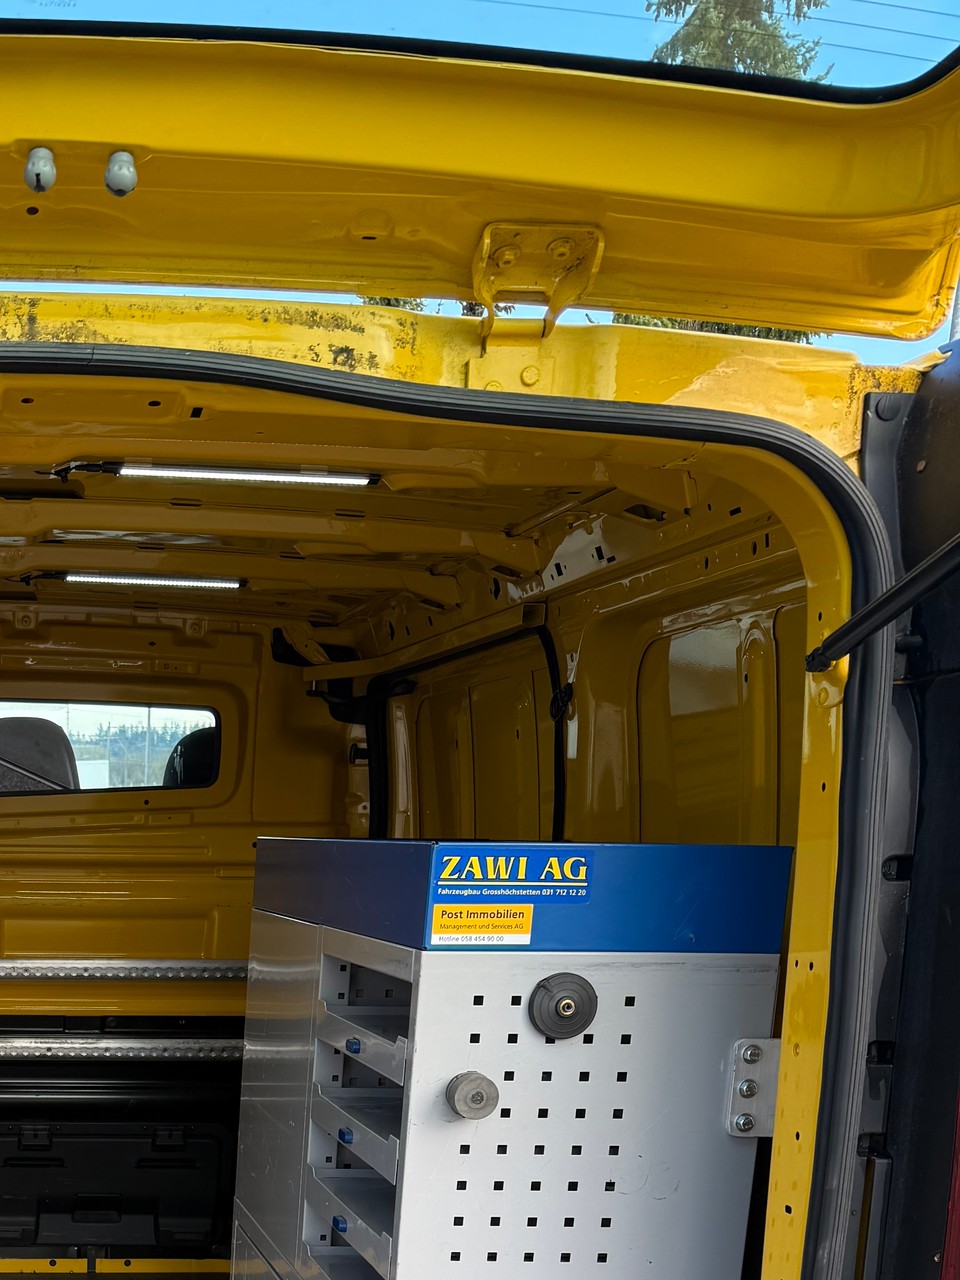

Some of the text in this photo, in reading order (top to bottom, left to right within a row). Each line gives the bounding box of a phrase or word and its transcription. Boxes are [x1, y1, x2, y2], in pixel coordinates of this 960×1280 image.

[440, 856, 587, 880] ZAWI AG
[438, 888, 481, 896] Fahrzeugbau
[441, 910, 525, 919] Post Immobilien
